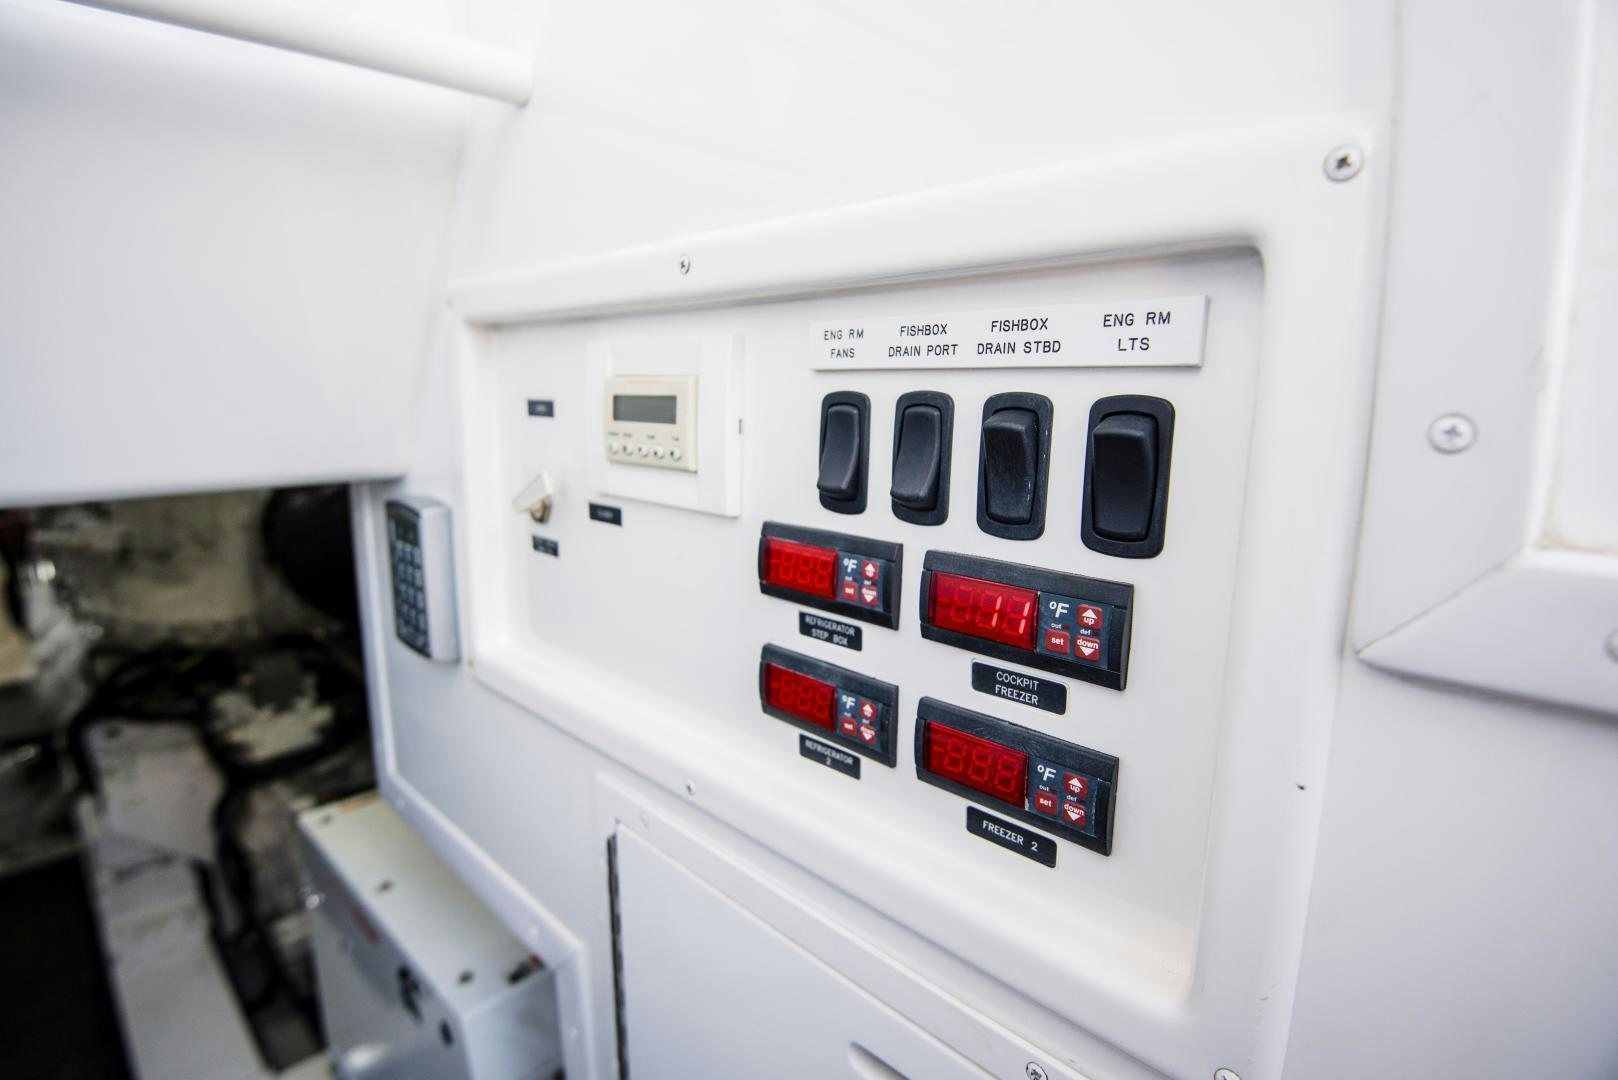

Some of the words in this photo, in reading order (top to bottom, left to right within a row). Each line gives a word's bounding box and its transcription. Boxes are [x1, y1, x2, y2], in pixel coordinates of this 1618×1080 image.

[991, 317, 1049, 333] FISHBOX
[1102, 313, 1136, 328] ENG
[1145, 311, 1172, 326] RM
[823, 329, 844, 341] ENG
[848, 328, 864, 340] RM
[899, 323, 948, 337] FISHBOX
[888, 345, 922, 358] DRAIN
[926, 343, 959, 357] PORT
[976, 341, 1017, 355] DRAIN
[1023, 340, 1062, 354] STBD
[1117, 337, 1151, 352] LTS
[830, 347, 856, 359] FANS
[805, 614, 856, 637] REFRIGERATOR
[1083, 616, 1095, 626] up
[811, 628, 830, 640] STEP
[833, 634, 849, 646] BOX
[1051, 637, 1065, 646] set
[1076, 638, 1099, 650] down
[996, 671, 1040, 691] COCKPIT
[995, 685, 1039, 706] FREEZER
[805, 739, 854, 766] REFRIGERATOR
[1070, 784, 1081, 794] up
[1039, 798, 1052, 808] set
[1063, 803, 1086, 817] down
[982, 820, 1025, 846] FREEZER
[1031, 841, 1039, 851] 2
